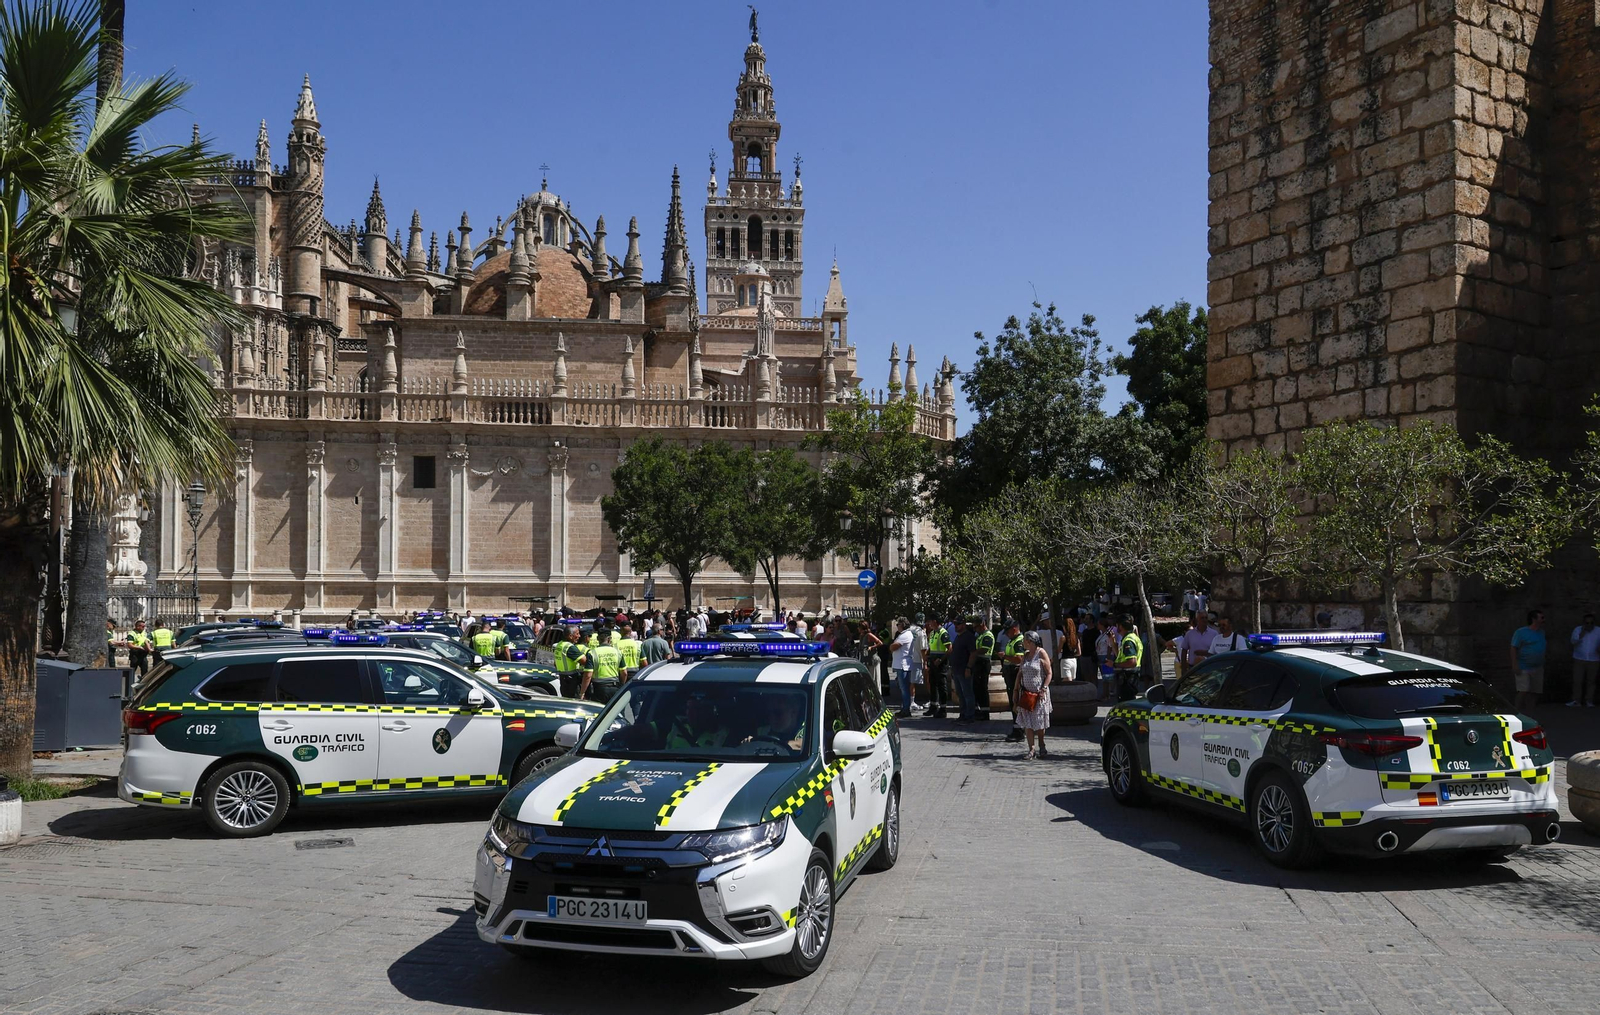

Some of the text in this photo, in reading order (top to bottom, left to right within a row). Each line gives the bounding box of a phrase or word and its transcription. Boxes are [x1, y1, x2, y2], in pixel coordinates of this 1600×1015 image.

[1387, 677, 1436, 686] GUARDIA
[195, 724, 217, 736] 062
[274, 733, 365, 745] GUARDIA CIVIL
[321, 743, 365, 753] TRÁFICO
[1203, 742, 1250, 760] GUARDIA CIVIL
[1204, 753, 1227, 766] TRÁFICO
[1453, 760, 1471, 770] 062
[1297, 760, 1314, 775] 062
[1448, 784, 1470, 797] PGC
[1472, 782, 1500, 797] 2133
[1501, 781, 1509, 794] U
[599, 794, 646, 803] TRÁFICO
[557, 898, 586, 917] PGC
[590, 901, 631, 920] 2314
[634, 903, 645, 920] U
